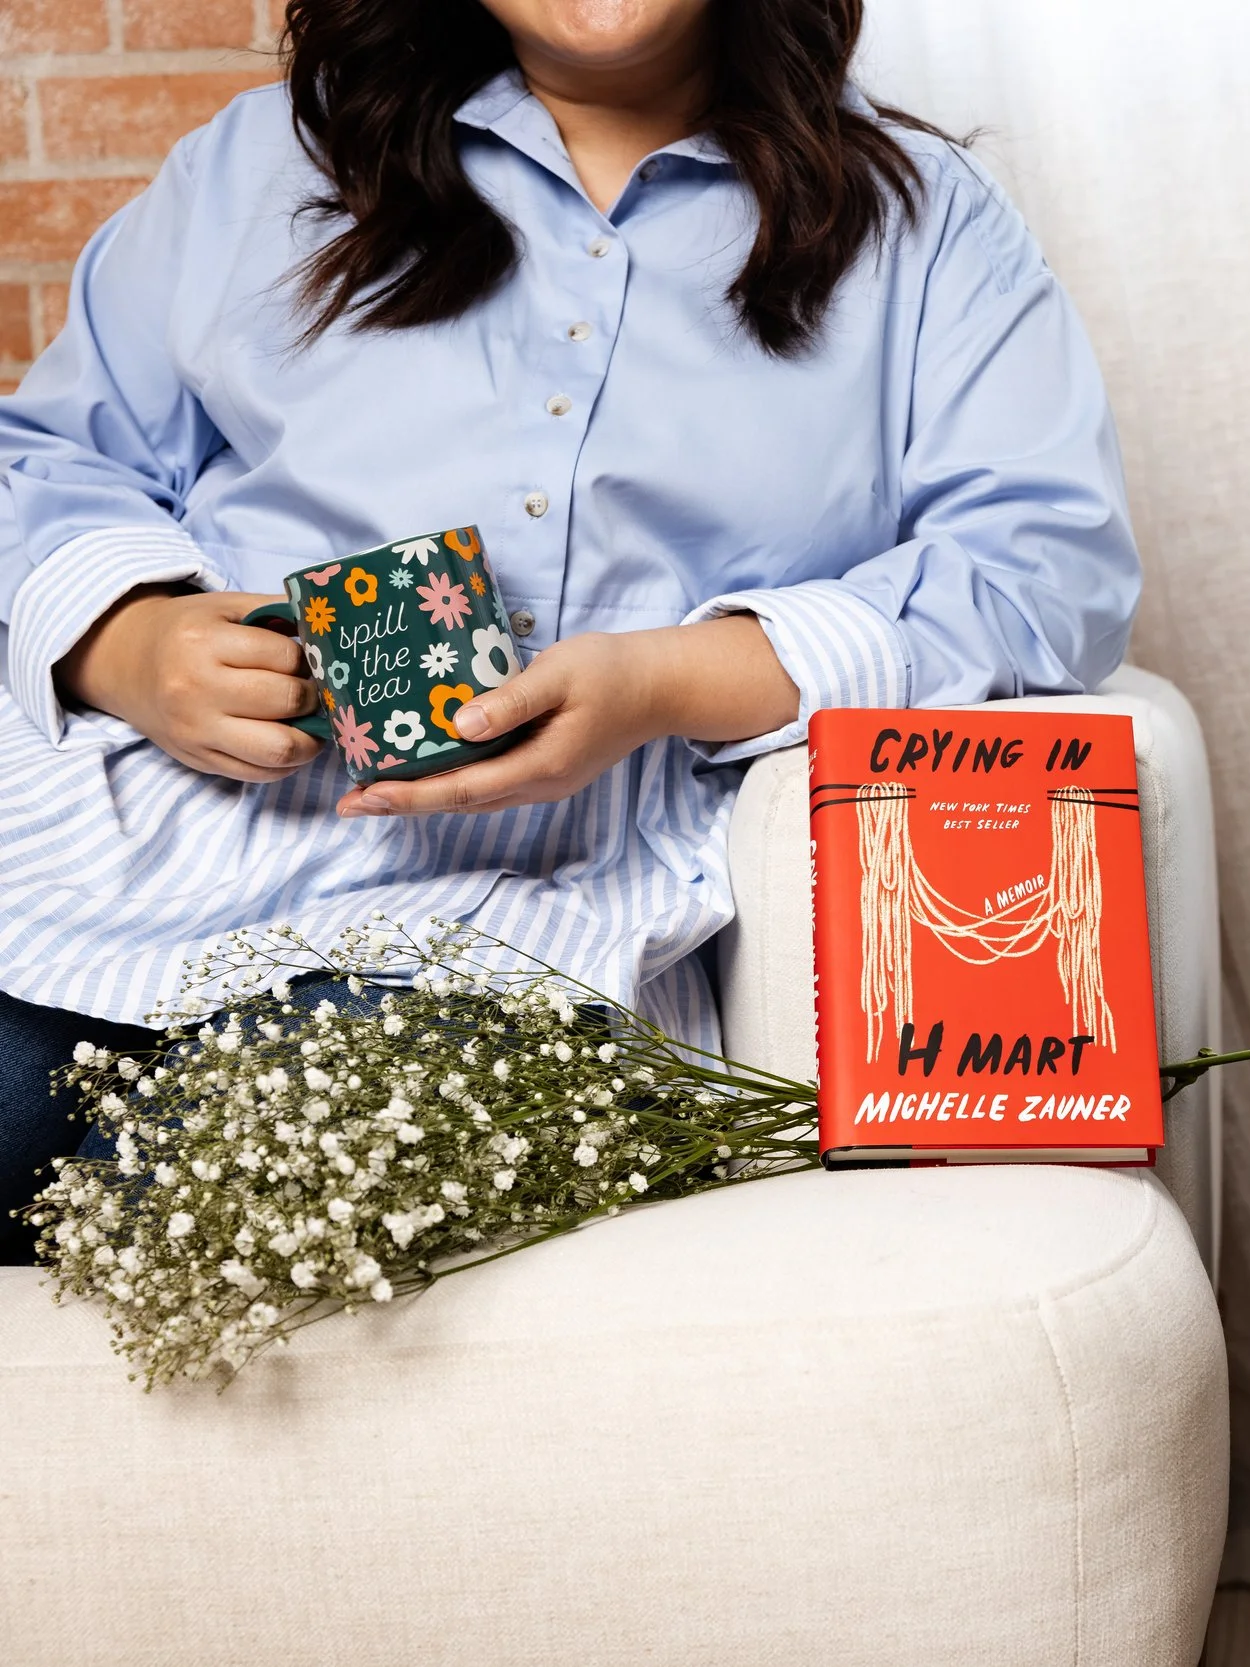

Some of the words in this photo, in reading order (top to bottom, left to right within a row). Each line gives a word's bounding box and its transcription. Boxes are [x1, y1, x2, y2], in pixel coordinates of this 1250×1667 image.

[339, 602, 409, 658] spill
[362, 645, 411, 679] the
[357, 676, 411, 707] tea
[870, 728, 1024, 774] CRYING
[1045, 738, 1093, 772] IN
[929, 802, 959, 812] NEW
[962, 802, 990, 813] YORK
[996, 803, 1032, 814] TIMES
[943, 819, 972, 830] BEST
[976, 819, 1020, 830] SELLER
[983, 897, 994, 917] A
[996, 873, 1045, 909] MEMOIR
[898, 1020, 944, 1077] H
[956, 1033, 1095, 1077] MART
[854, 1091, 1009, 1125] MICHELLE
[1018, 1093, 1132, 1122] ZAUNER
